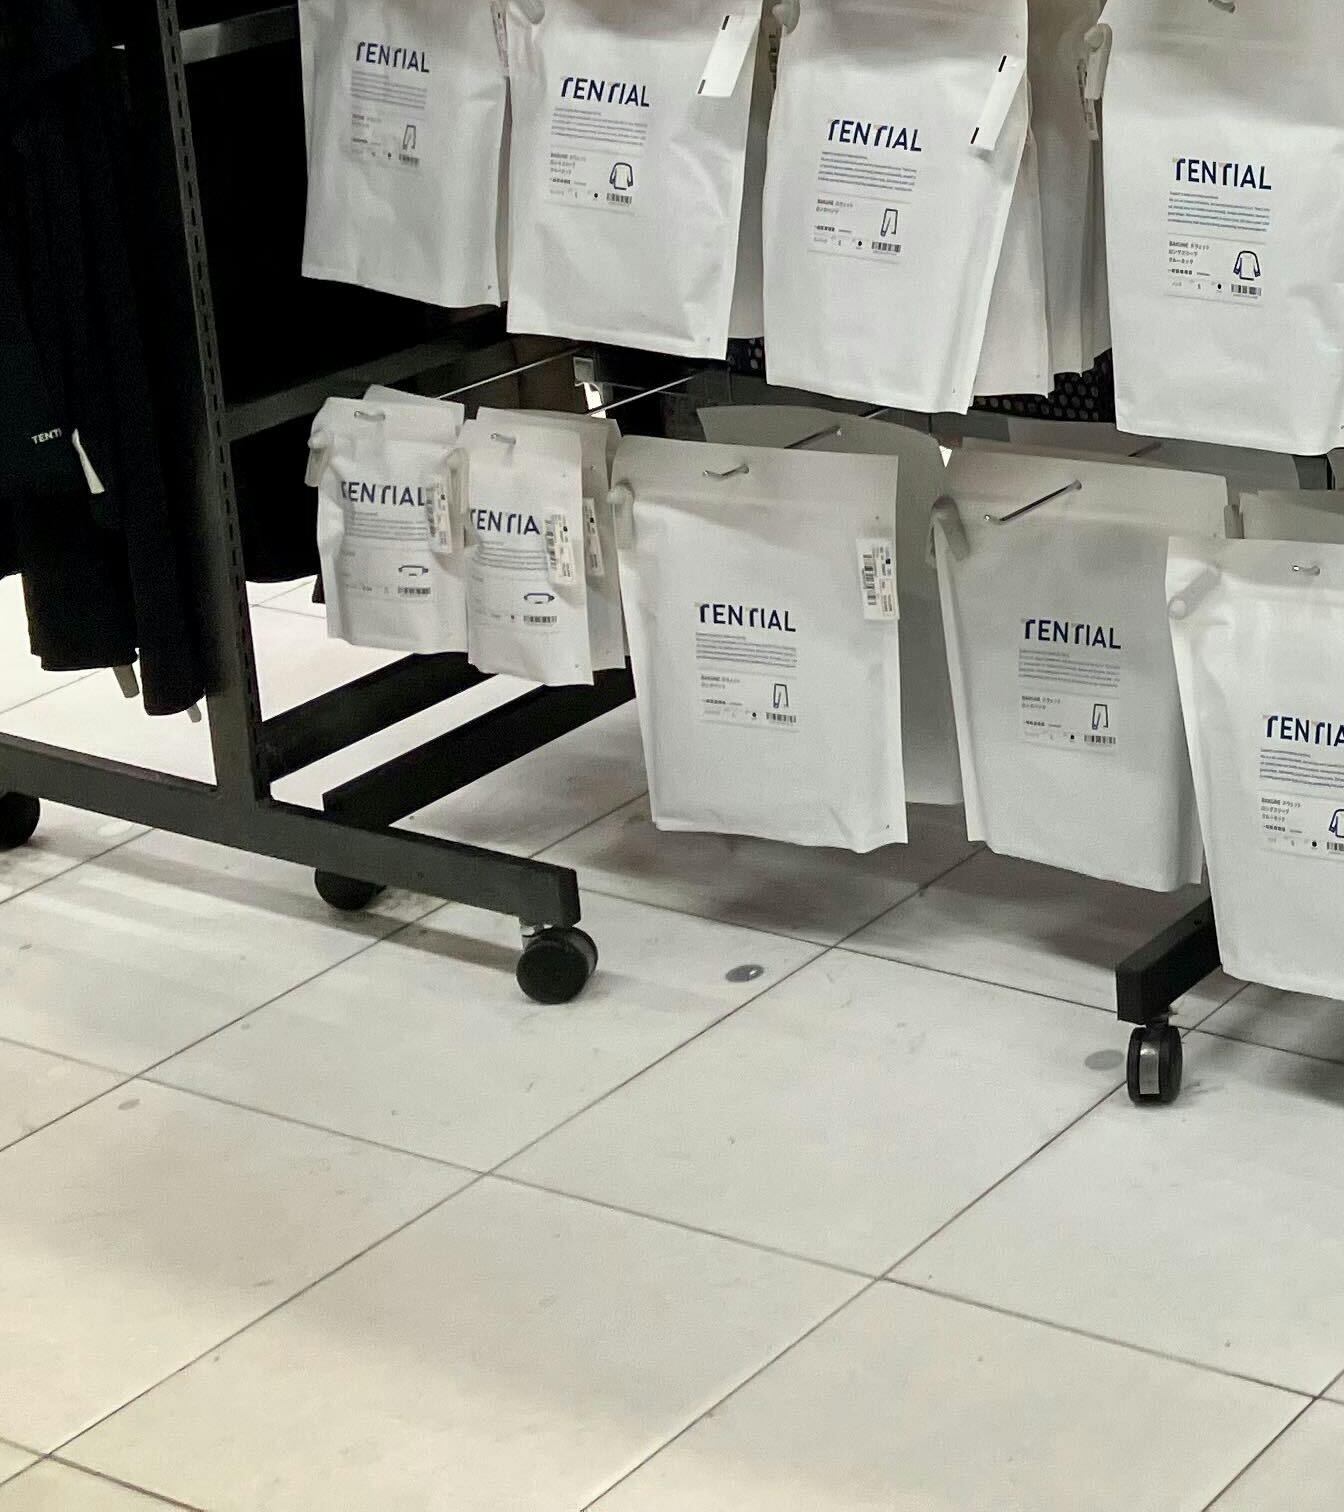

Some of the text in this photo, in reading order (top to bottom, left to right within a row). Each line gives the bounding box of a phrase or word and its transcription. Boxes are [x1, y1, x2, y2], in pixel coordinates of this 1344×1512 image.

[356, 39, 430, 74] TENTIAL
[560, 75, 650, 108] TENTIAL
[827, 118, 922, 153] TENTIAL
[1173, 157, 1272, 191] TENTIAL
[469, 506, 540, 538] TENTIA
[695, 601, 797, 634] TENTIAL
[1022, 618, 1122, 651] TENTIAL
